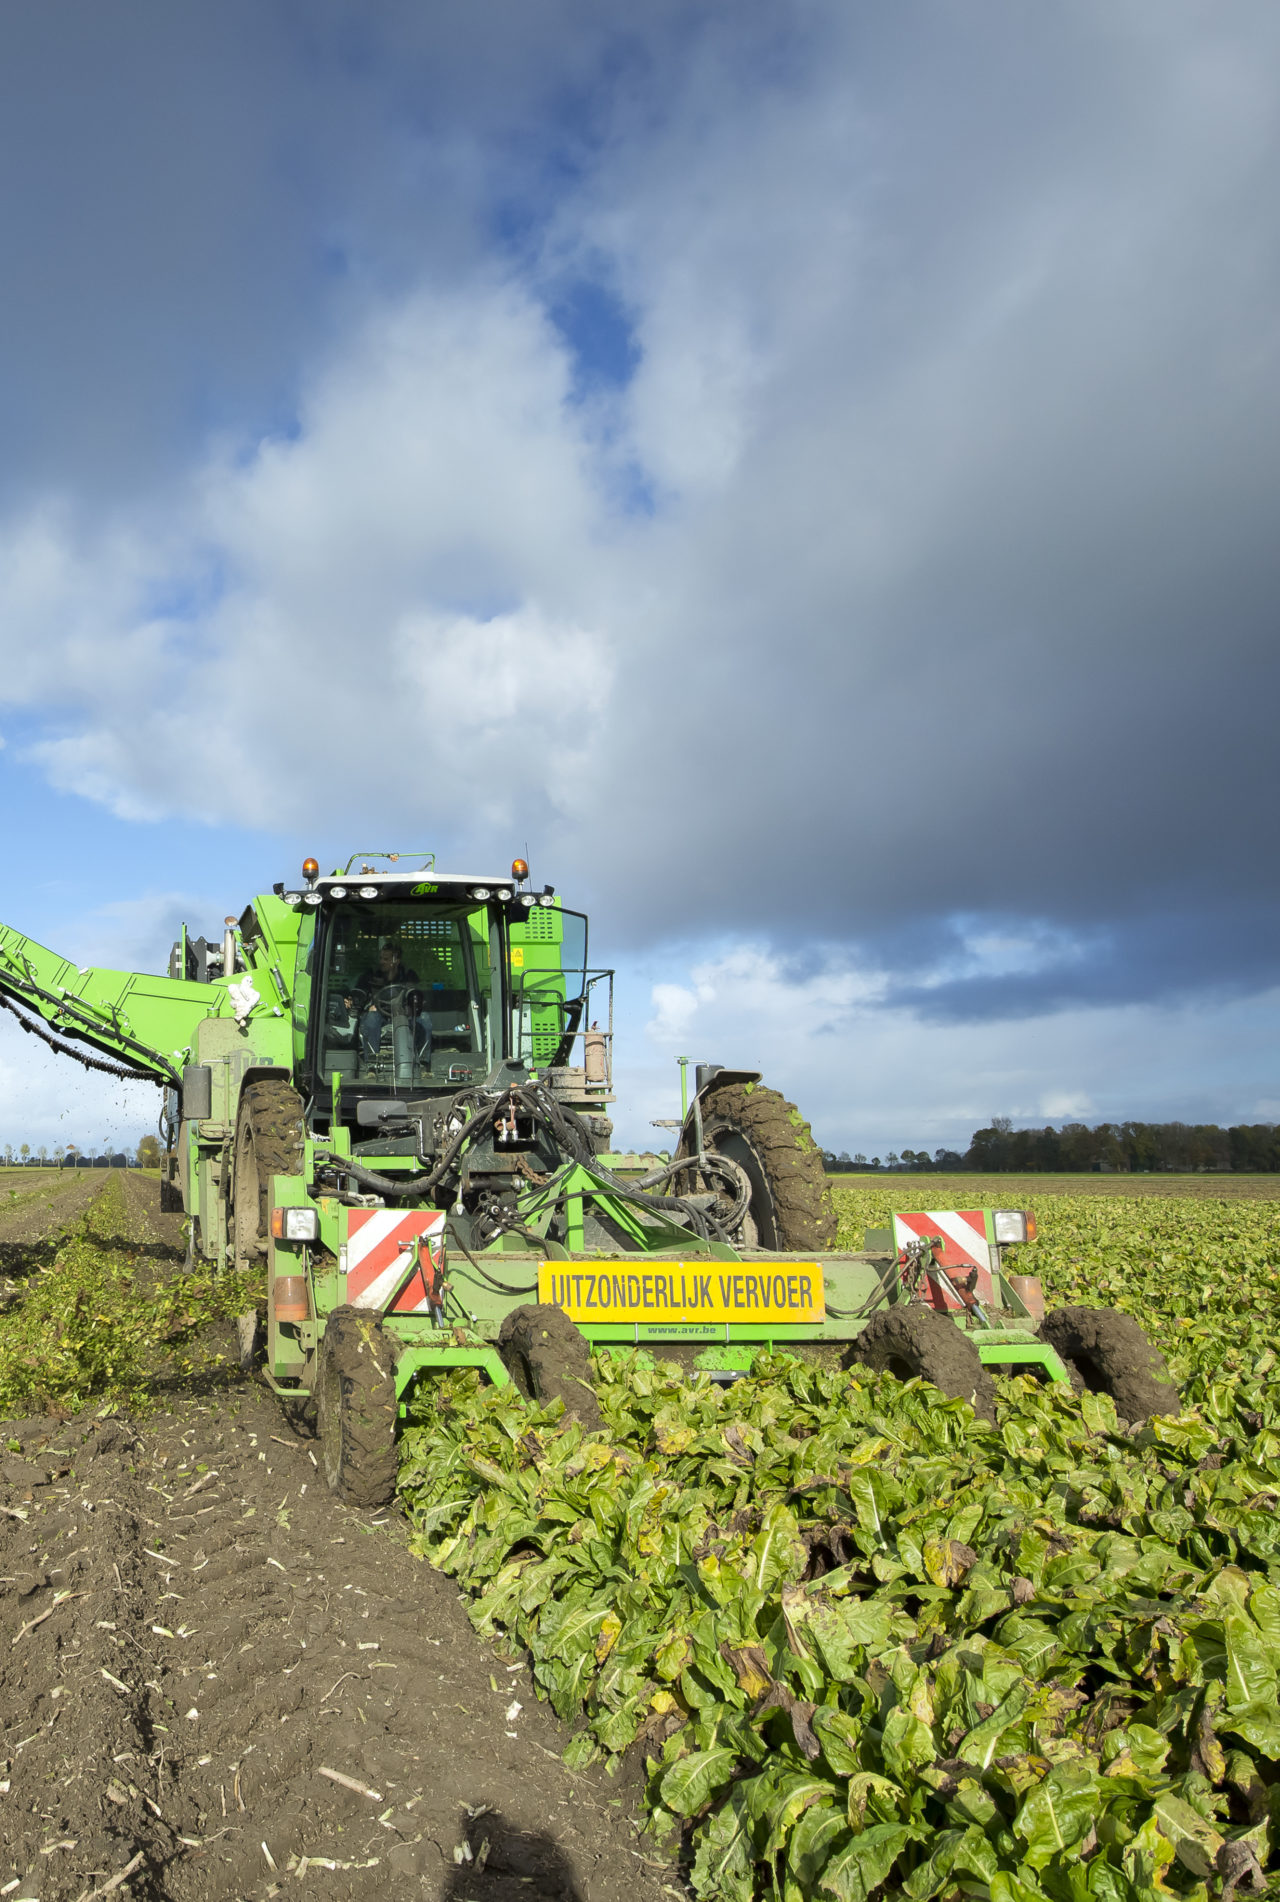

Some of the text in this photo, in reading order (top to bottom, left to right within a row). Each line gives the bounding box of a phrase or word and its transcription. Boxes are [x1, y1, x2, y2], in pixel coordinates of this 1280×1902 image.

[551, 1274, 814, 1309] UITZONDERLIJK VERVOER
[648, 1326, 716, 1334] www.avr.be
